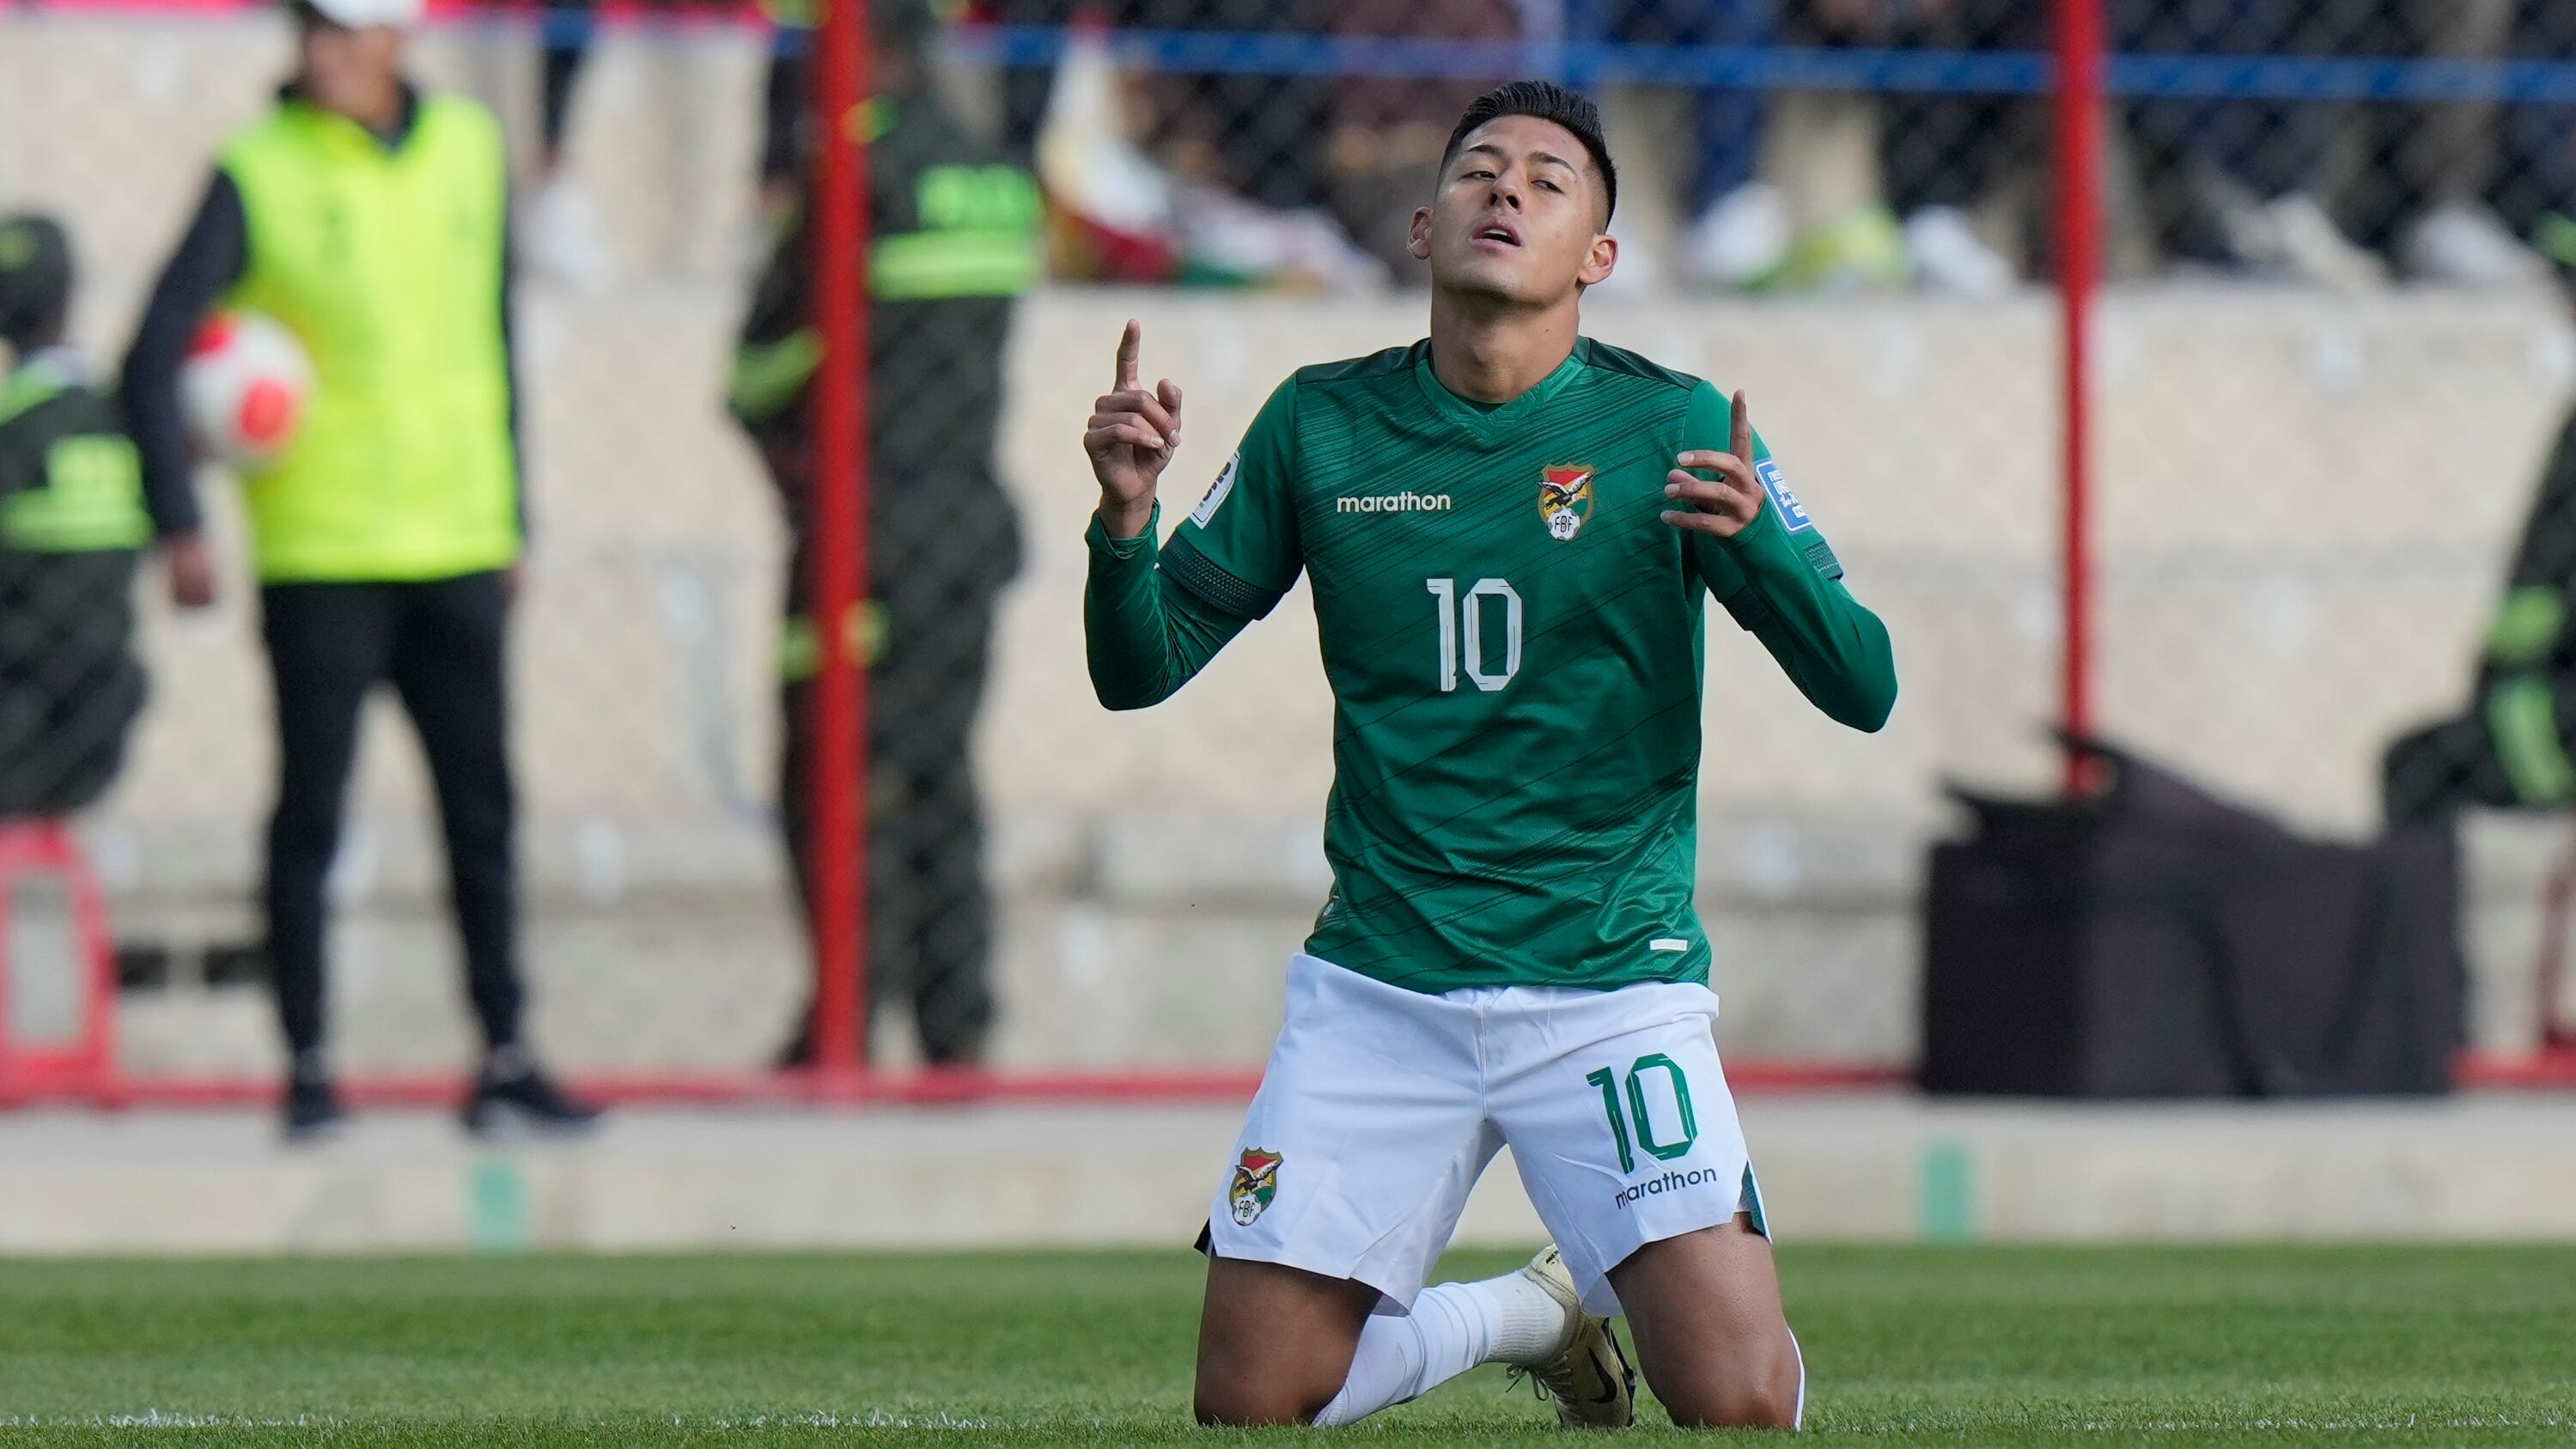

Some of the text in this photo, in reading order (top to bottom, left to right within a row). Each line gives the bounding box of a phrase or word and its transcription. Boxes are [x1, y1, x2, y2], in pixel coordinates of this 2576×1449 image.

[1337, 491, 1451, 512] marathon
[1555, 515, 1573, 533] FBF
[1427, 578, 1522, 691] 10
[1586, 1052, 1698, 1175] 10
[1615, 1168, 1717, 1209] marathon
